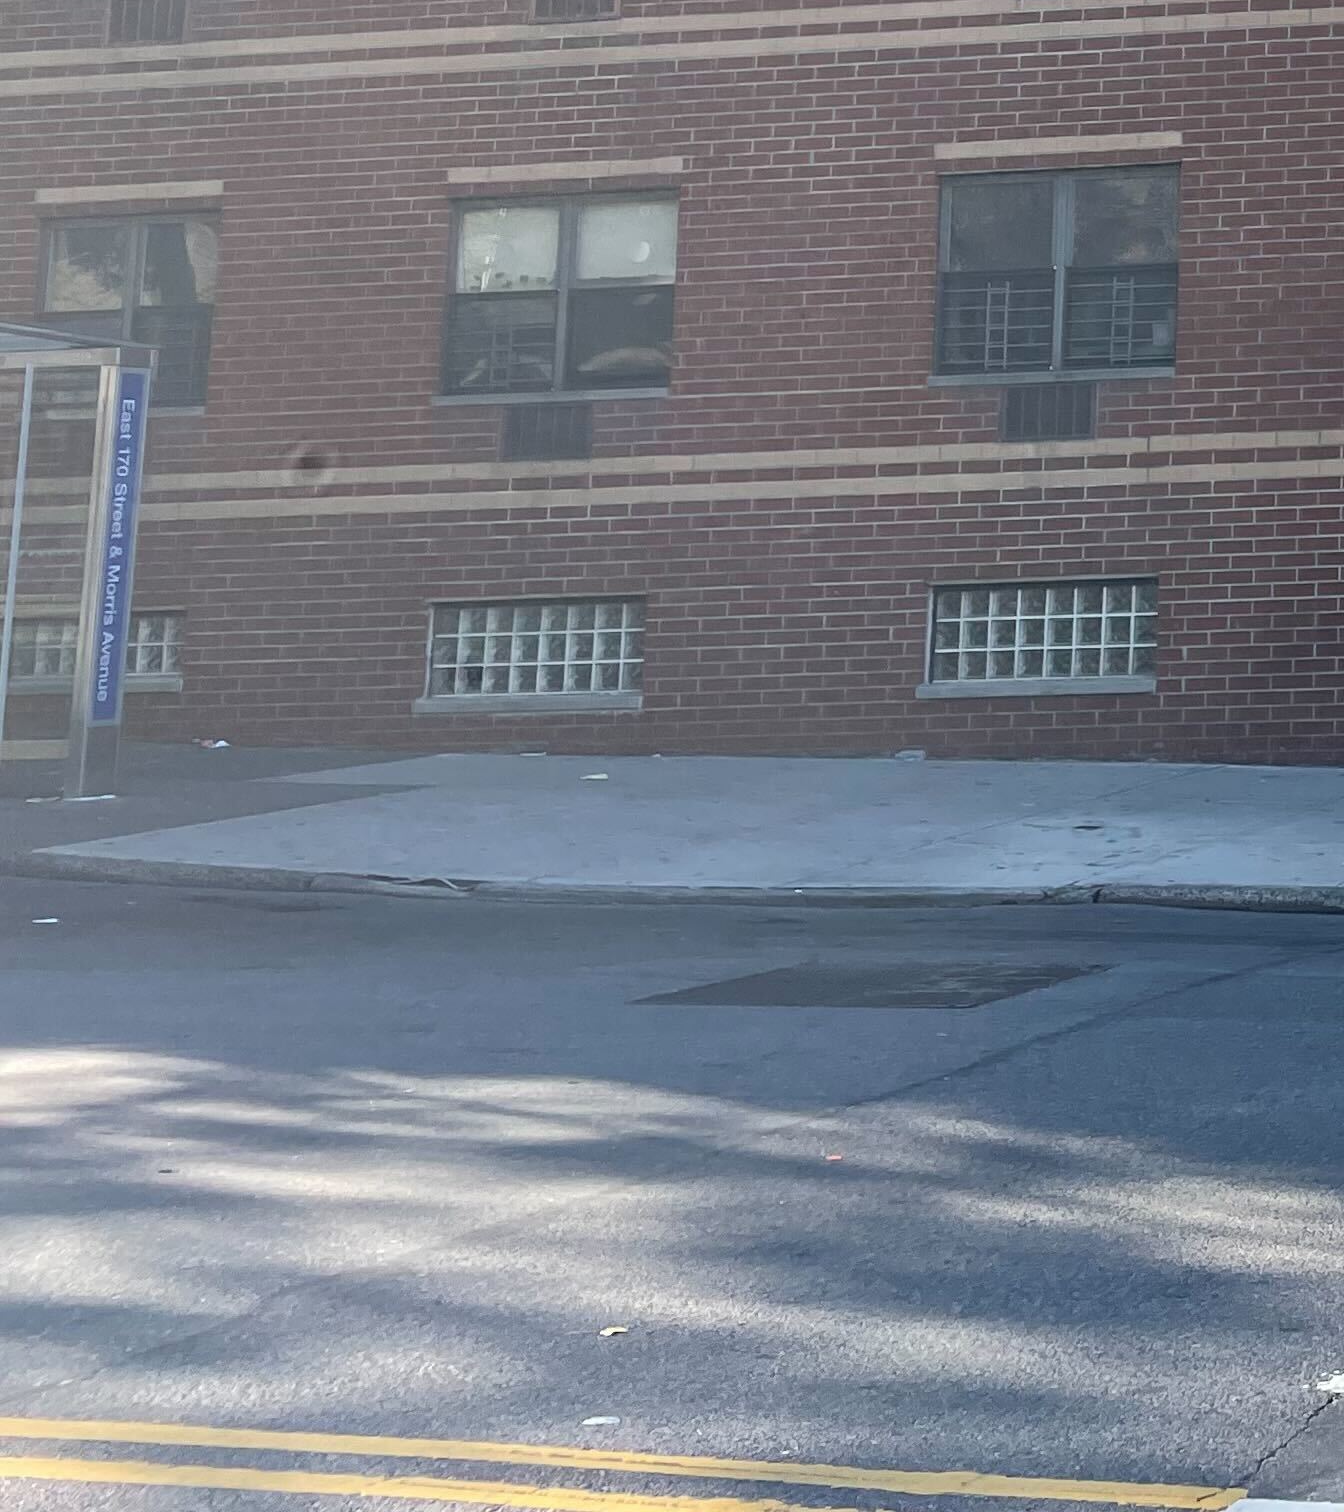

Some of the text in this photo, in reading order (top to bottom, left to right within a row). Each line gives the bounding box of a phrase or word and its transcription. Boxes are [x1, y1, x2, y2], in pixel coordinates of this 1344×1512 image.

[97, 399, 135, 702] East 170 Street & Morris Avenue
